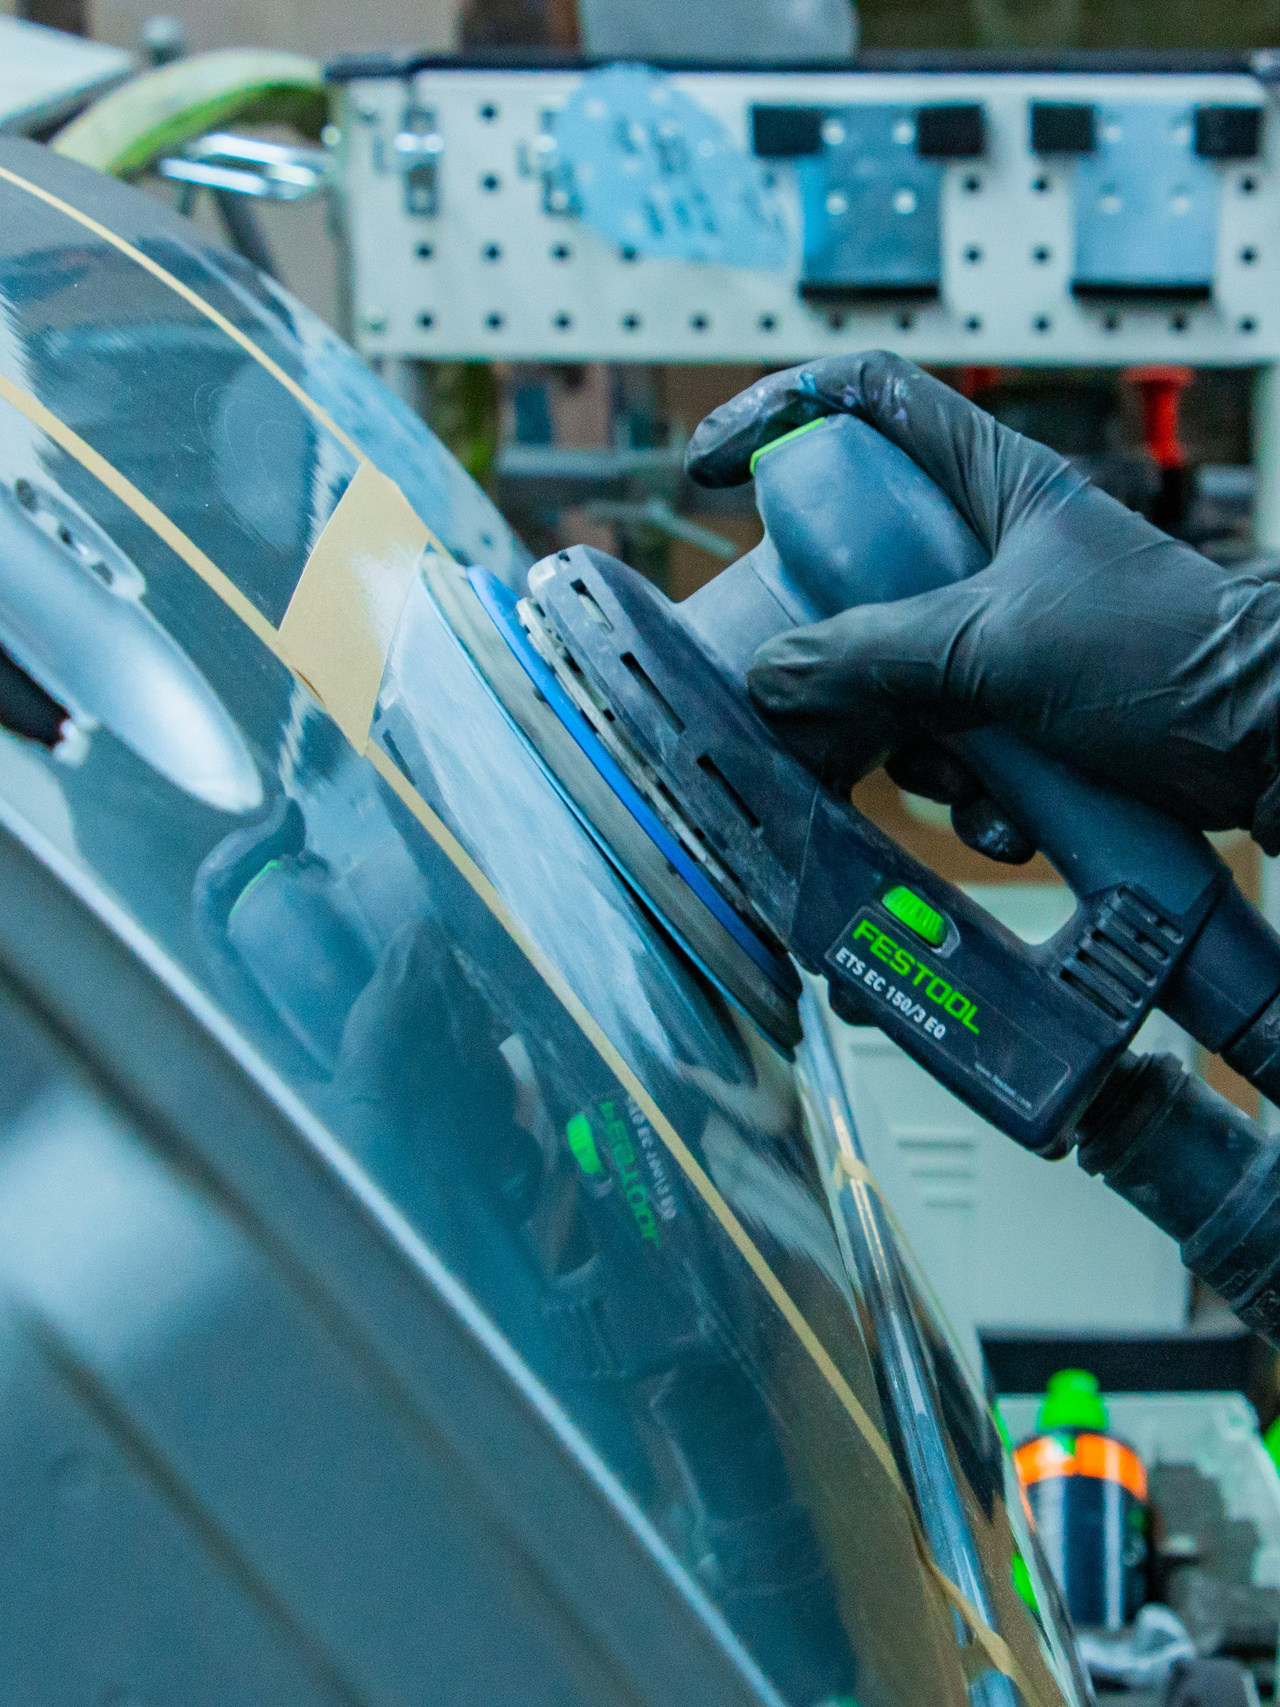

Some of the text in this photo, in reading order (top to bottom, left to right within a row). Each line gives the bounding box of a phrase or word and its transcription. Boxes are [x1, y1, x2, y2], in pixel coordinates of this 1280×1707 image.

[835, 947, 947, 1040] ETS EC 150/3 EQ
[852, 918, 980, 1034] FESTOOL
